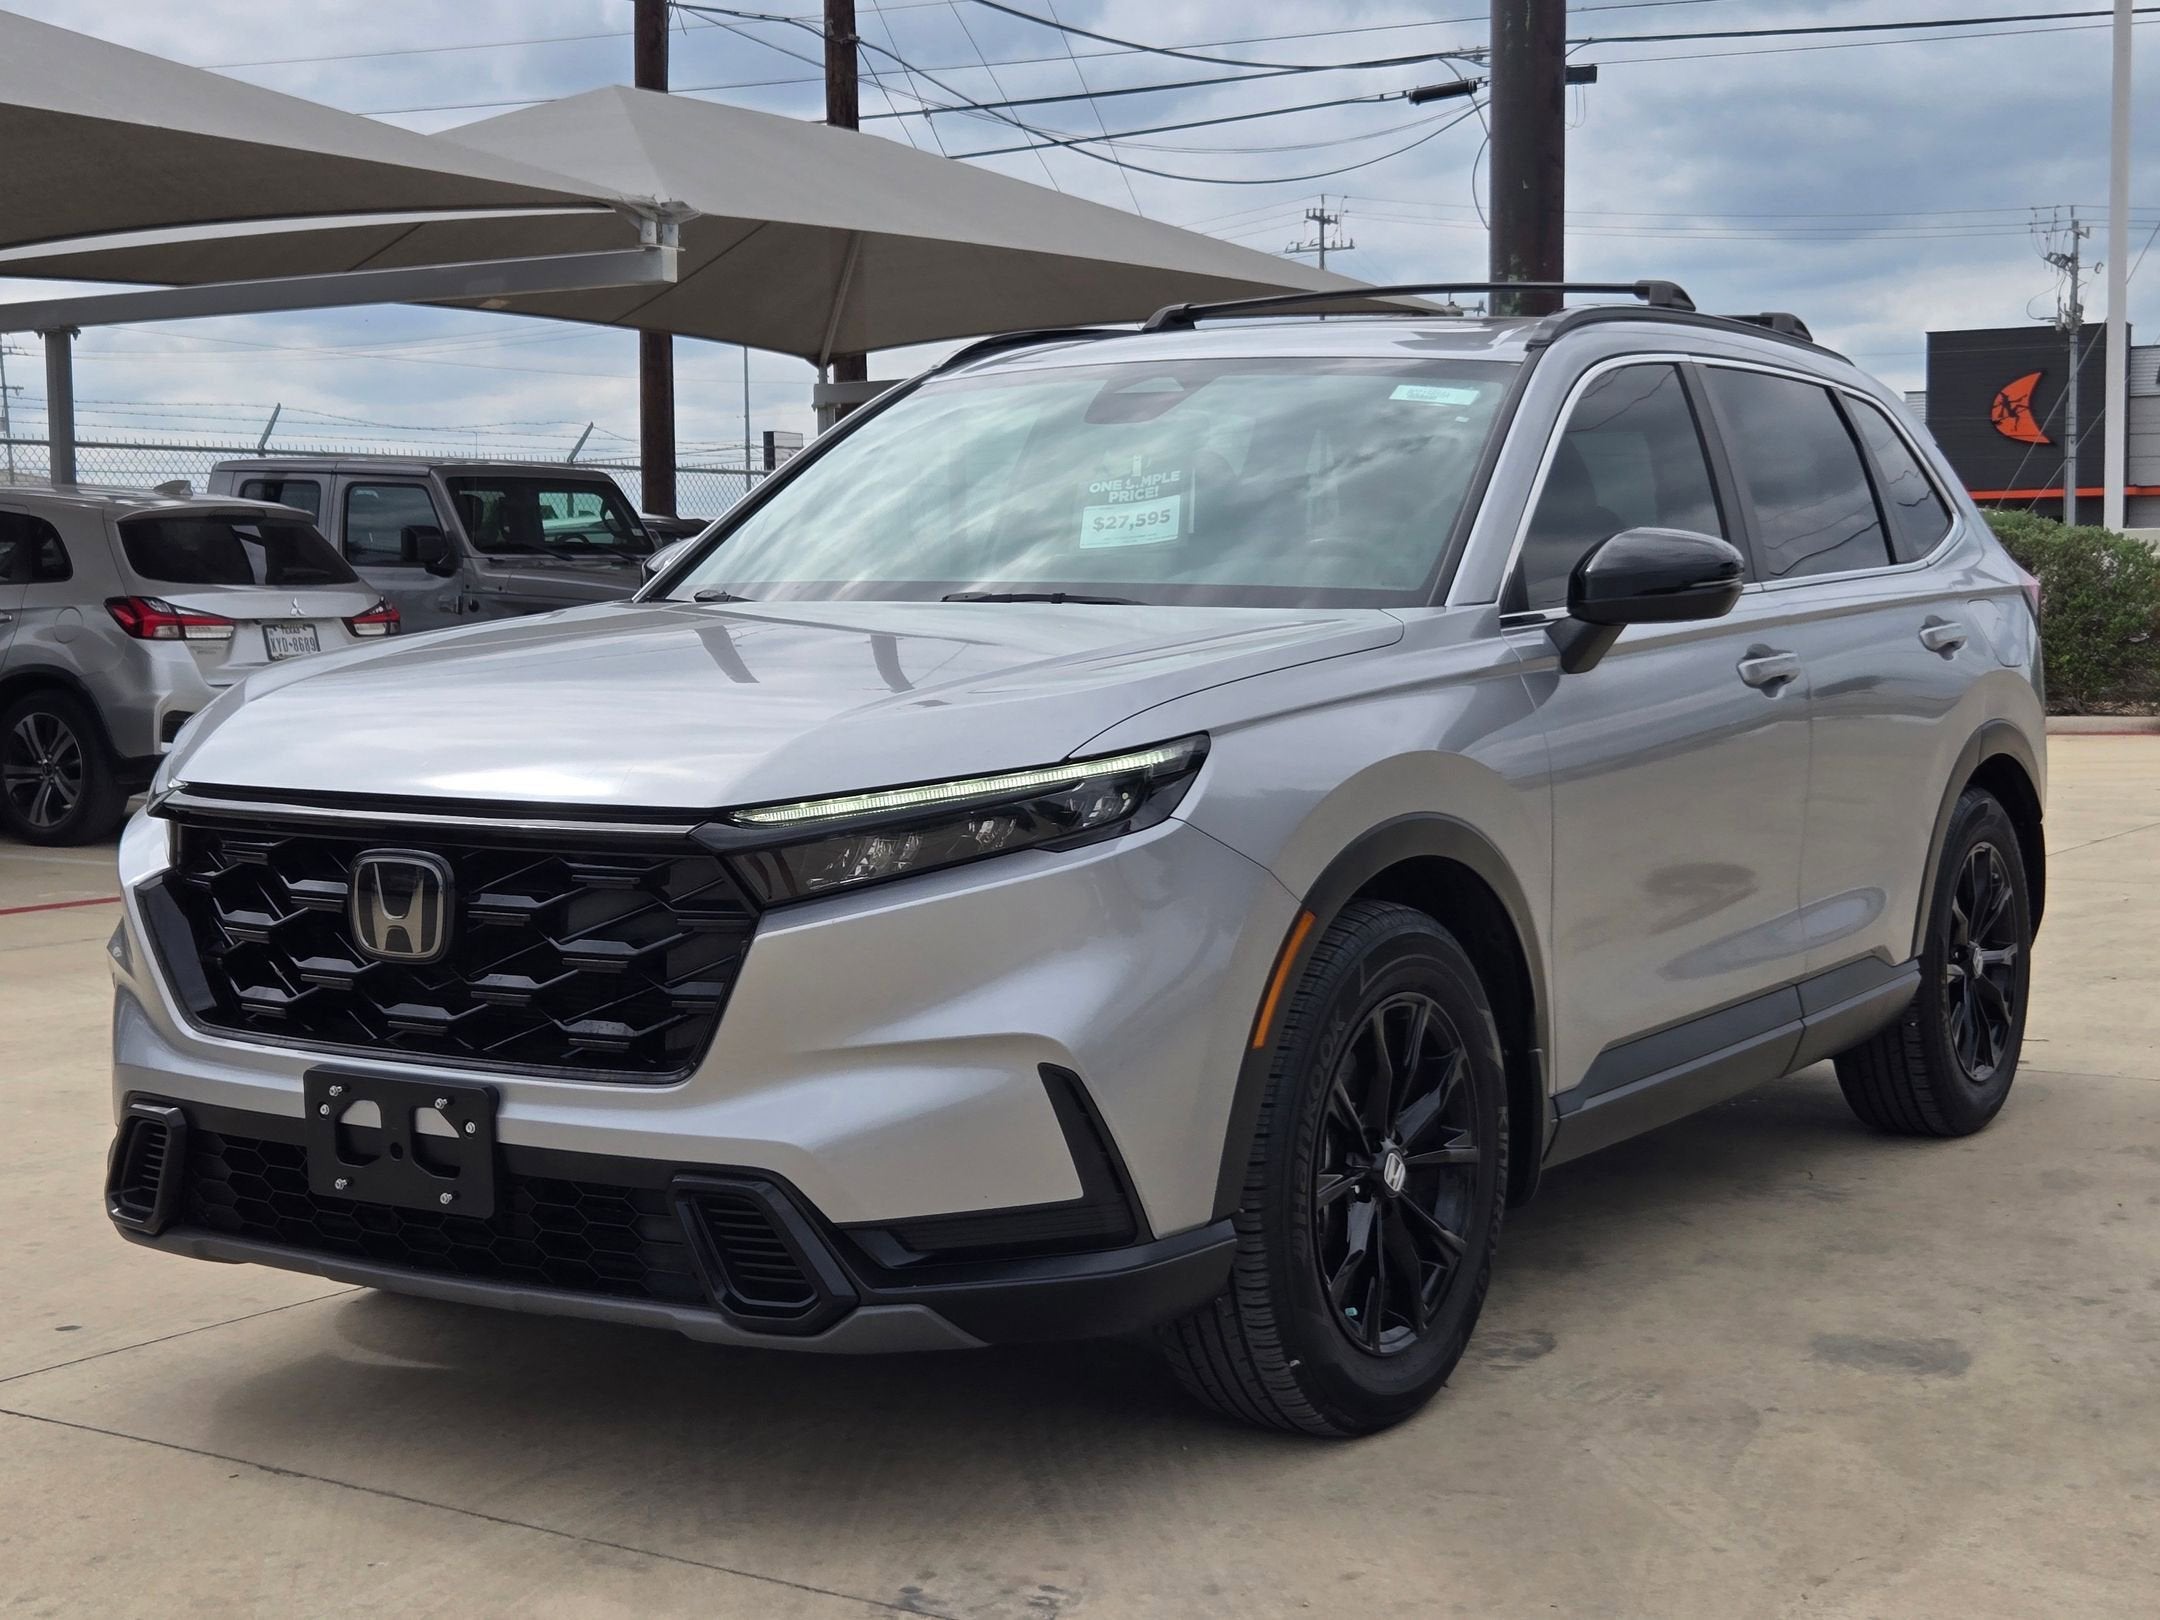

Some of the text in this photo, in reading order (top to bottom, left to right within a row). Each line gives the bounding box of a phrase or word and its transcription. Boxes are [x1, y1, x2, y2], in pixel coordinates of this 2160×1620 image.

[1089, 470, 1181, 494] ONE SMPLE
[1109, 487, 1160, 503] PRICE!
[1093, 509, 1170, 532] $27,595
